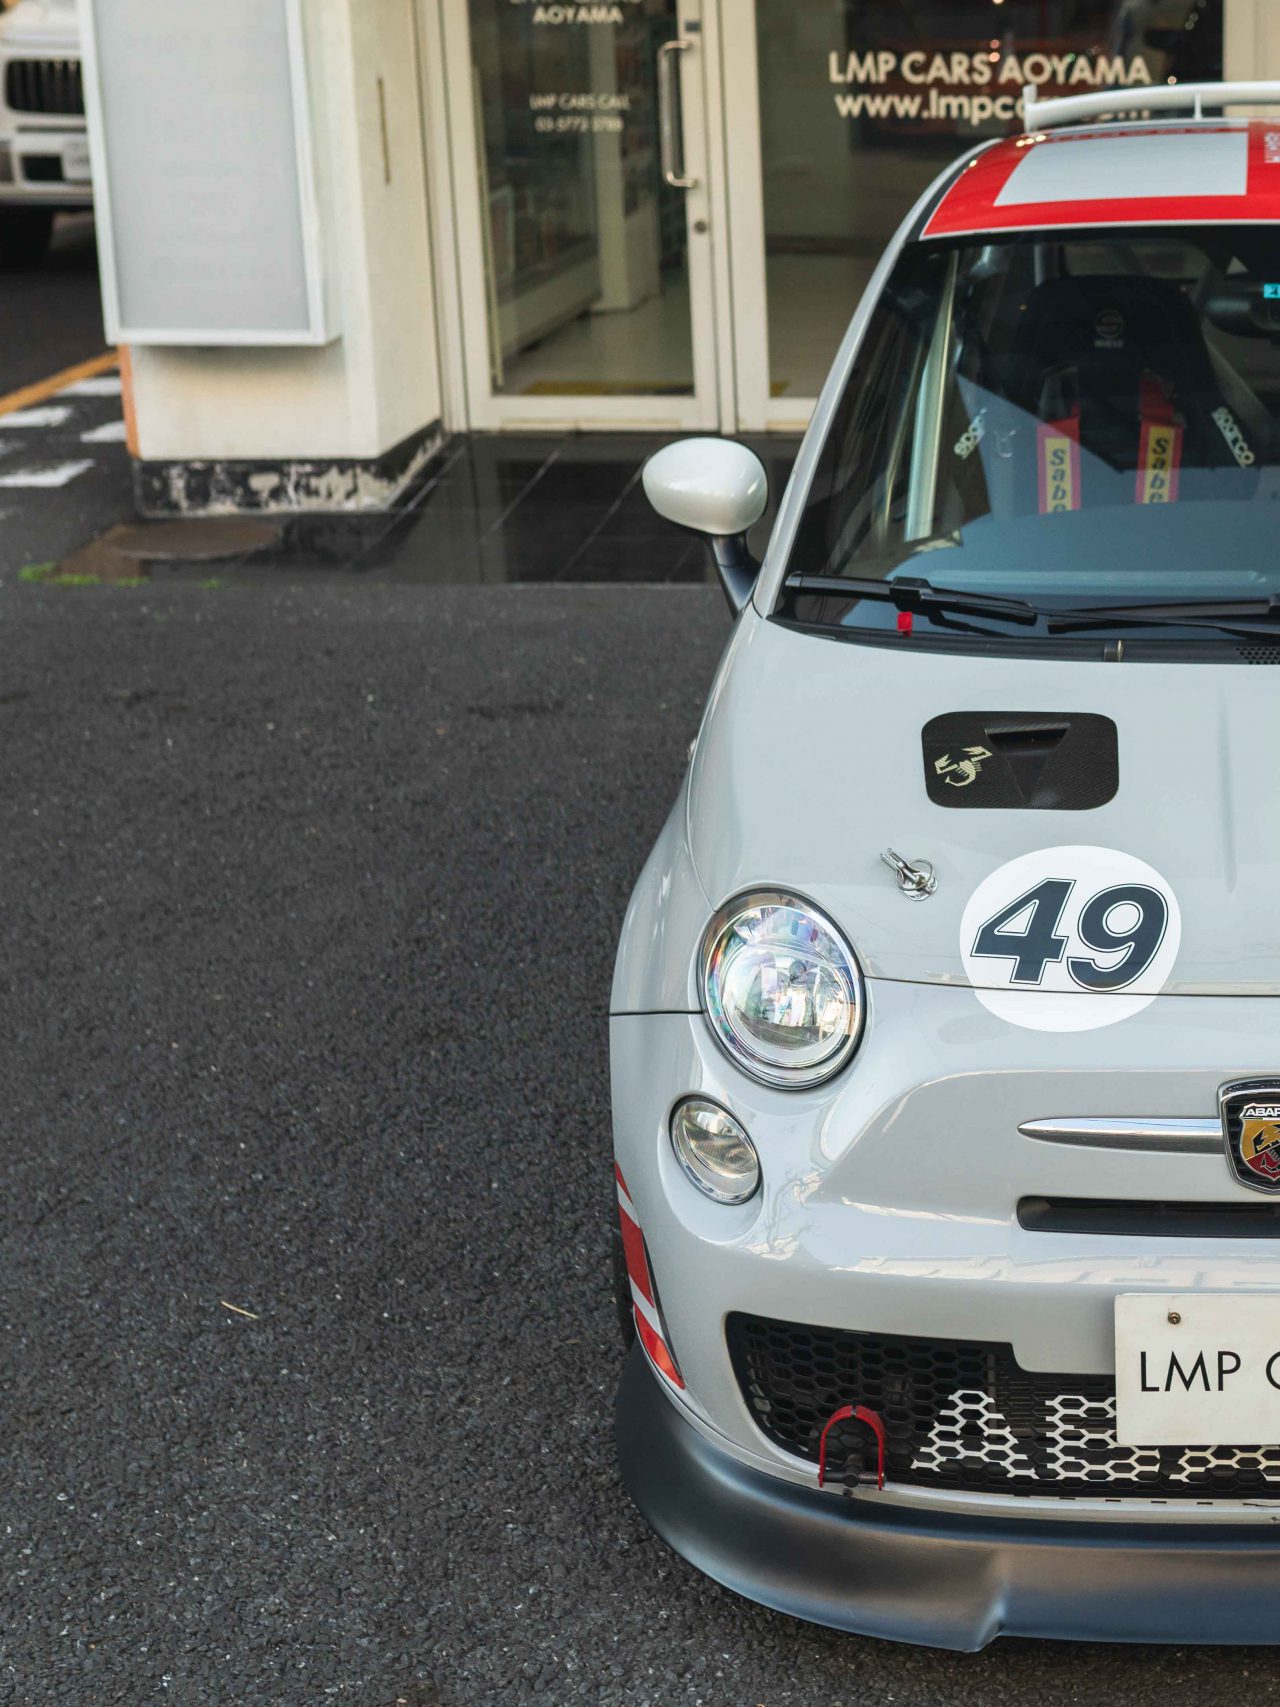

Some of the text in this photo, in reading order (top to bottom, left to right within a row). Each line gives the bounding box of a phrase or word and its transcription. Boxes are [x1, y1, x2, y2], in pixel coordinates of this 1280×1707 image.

[533, 5, 624, 25] AOYAMA
[829, 51, 1152, 85] LMP CARS AOYAMA
[970, 878, 1169, 992] 49
[1140, 1349, 1242, 1392] LMP
